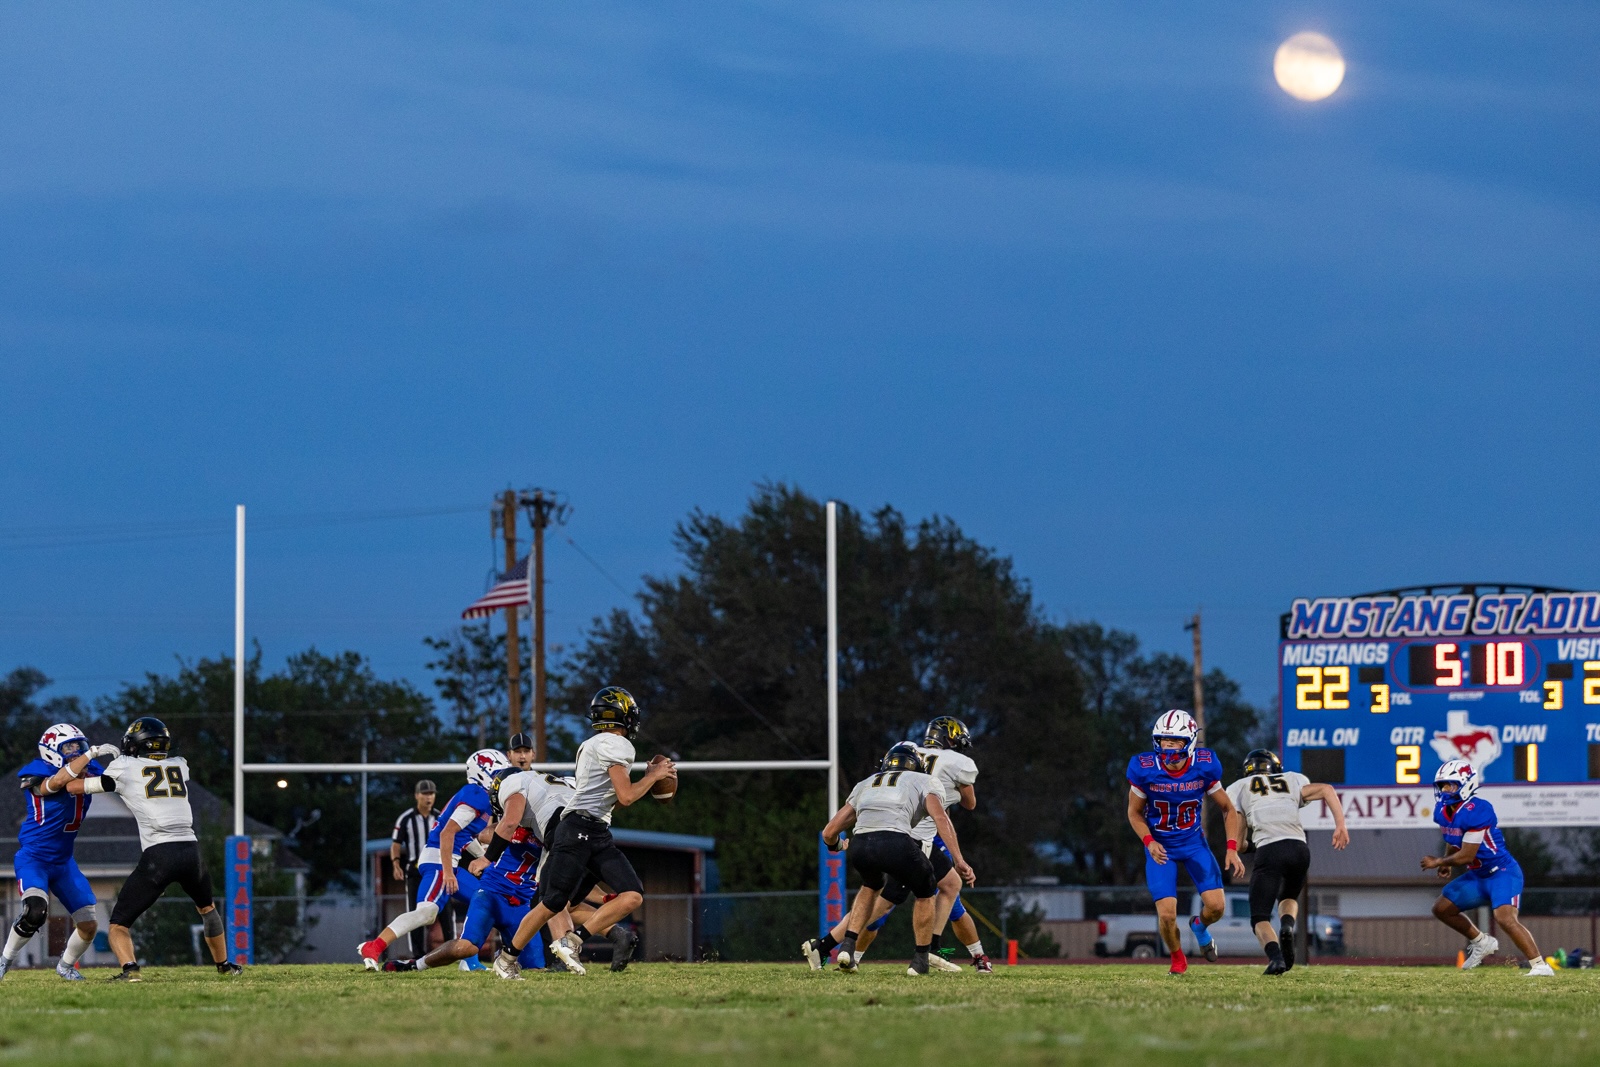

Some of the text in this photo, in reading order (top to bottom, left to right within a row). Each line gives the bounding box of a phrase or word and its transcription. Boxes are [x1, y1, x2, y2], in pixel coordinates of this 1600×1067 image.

[1289, 596, 1473, 638] MUSTANG
[1283, 643, 1389, 666] MUSTANGS
[1557, 638, 1600, 661] VISI
[1296, 666, 1349, 710] 22
[1370, 684, 1390, 713] 3
[1391, 692, 1412, 705] TOL
[1519, 690, 1541, 703] TOL
[1543, 680, 1563, 710] 3
[1286, 727, 1359, 747] BALL ON
[1390, 726, 1425, 746] QTR
[1502, 724, 1547, 744] DWN
[1396, 745, 1421, 784] 2
[1527, 743, 1538, 782] 1
[141, 765, 187, 799] 29
[1150, 780, 1204, 792] MUSTANGS
[1249, 774, 1290, 797] 45
[1154, 798, 1200, 832] 10
